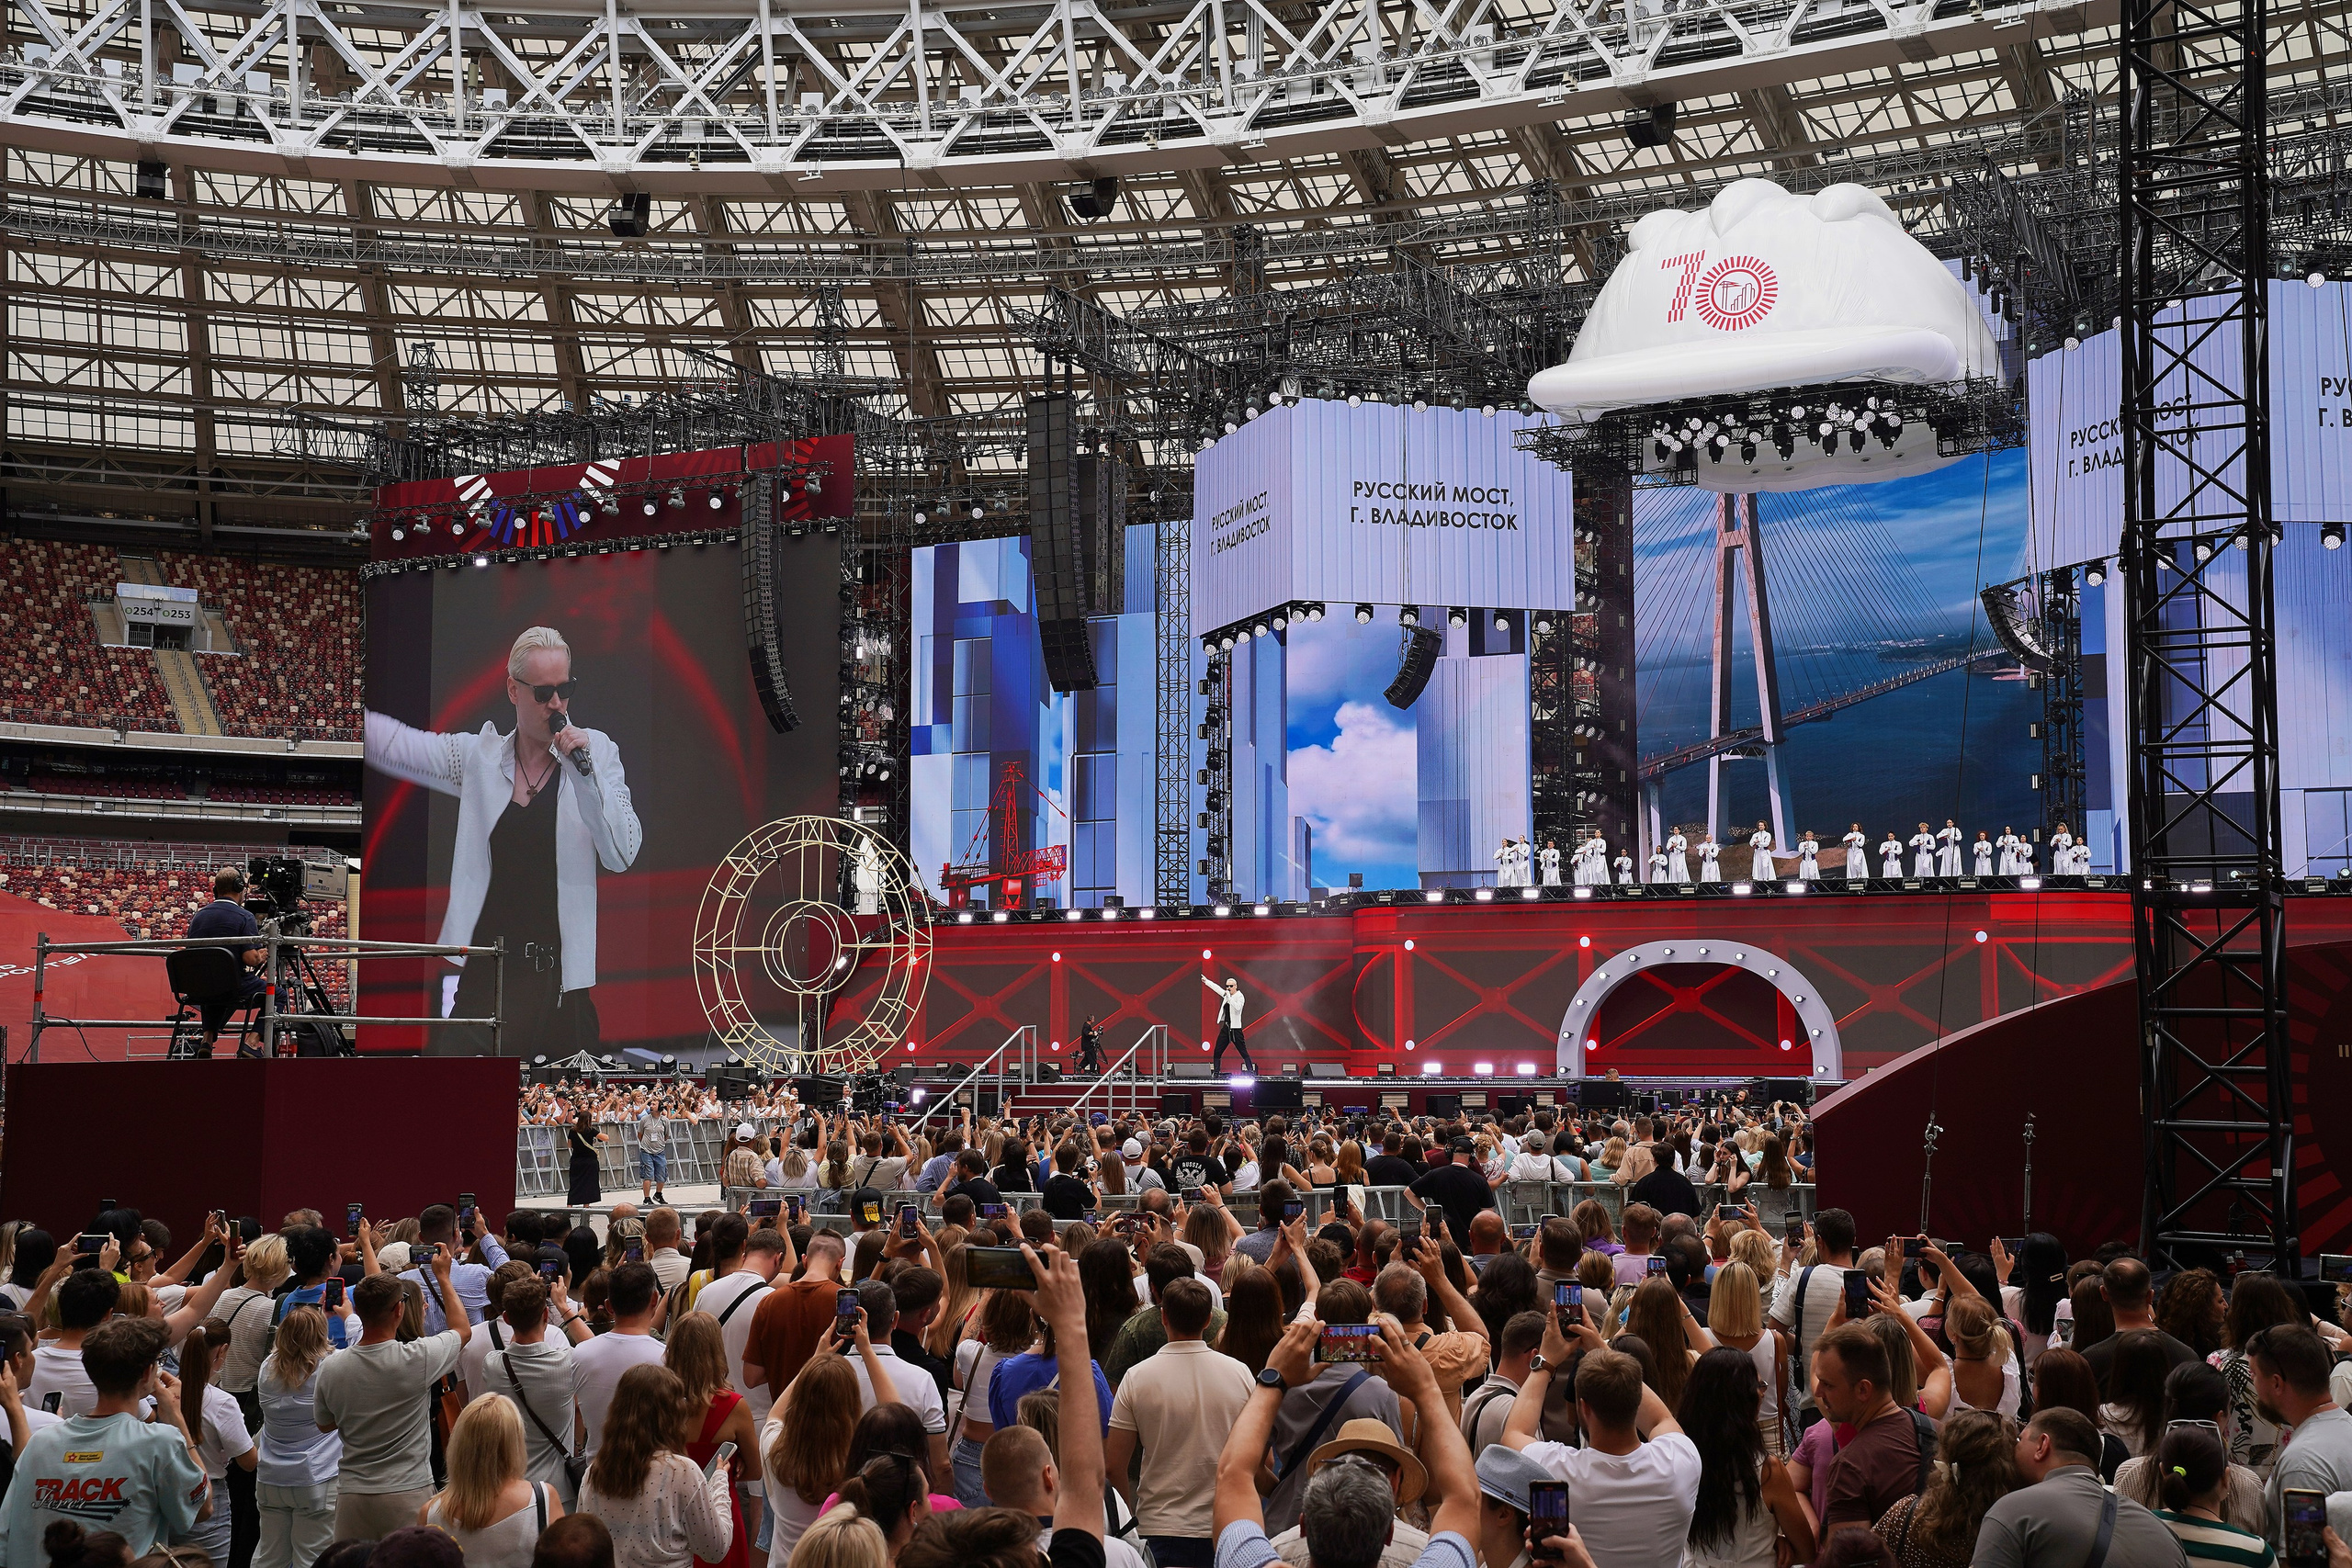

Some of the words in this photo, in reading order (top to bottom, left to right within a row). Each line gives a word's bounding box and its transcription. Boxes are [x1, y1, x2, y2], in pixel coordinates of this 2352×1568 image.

[2318, 407, 2335, 428] Г.
[2068, 459, 2079, 479] Г.
[1353, 480, 1446, 502] РУССКИЙ
[1452, 486, 1514, 508] МОСТ,
[1212, 499, 1244, 533] РУССКИЙ
[1245, 490, 1270, 516] МОСТ,
[1350, 506, 1364, 525] Г.
[1371, 507, 1519, 531] ВЛАДИВОСТОК
[1210, 540, 1216, 558] Г.
[1217, 514, 1271, 554] ВЛАДИВОСТОК
[132, 606, 154, 616] 254
[170, 609, 191, 619] 253
[1182, 1161, 1203, 1170] RUSSIA
[34, 1477, 130, 1502] TRACK
